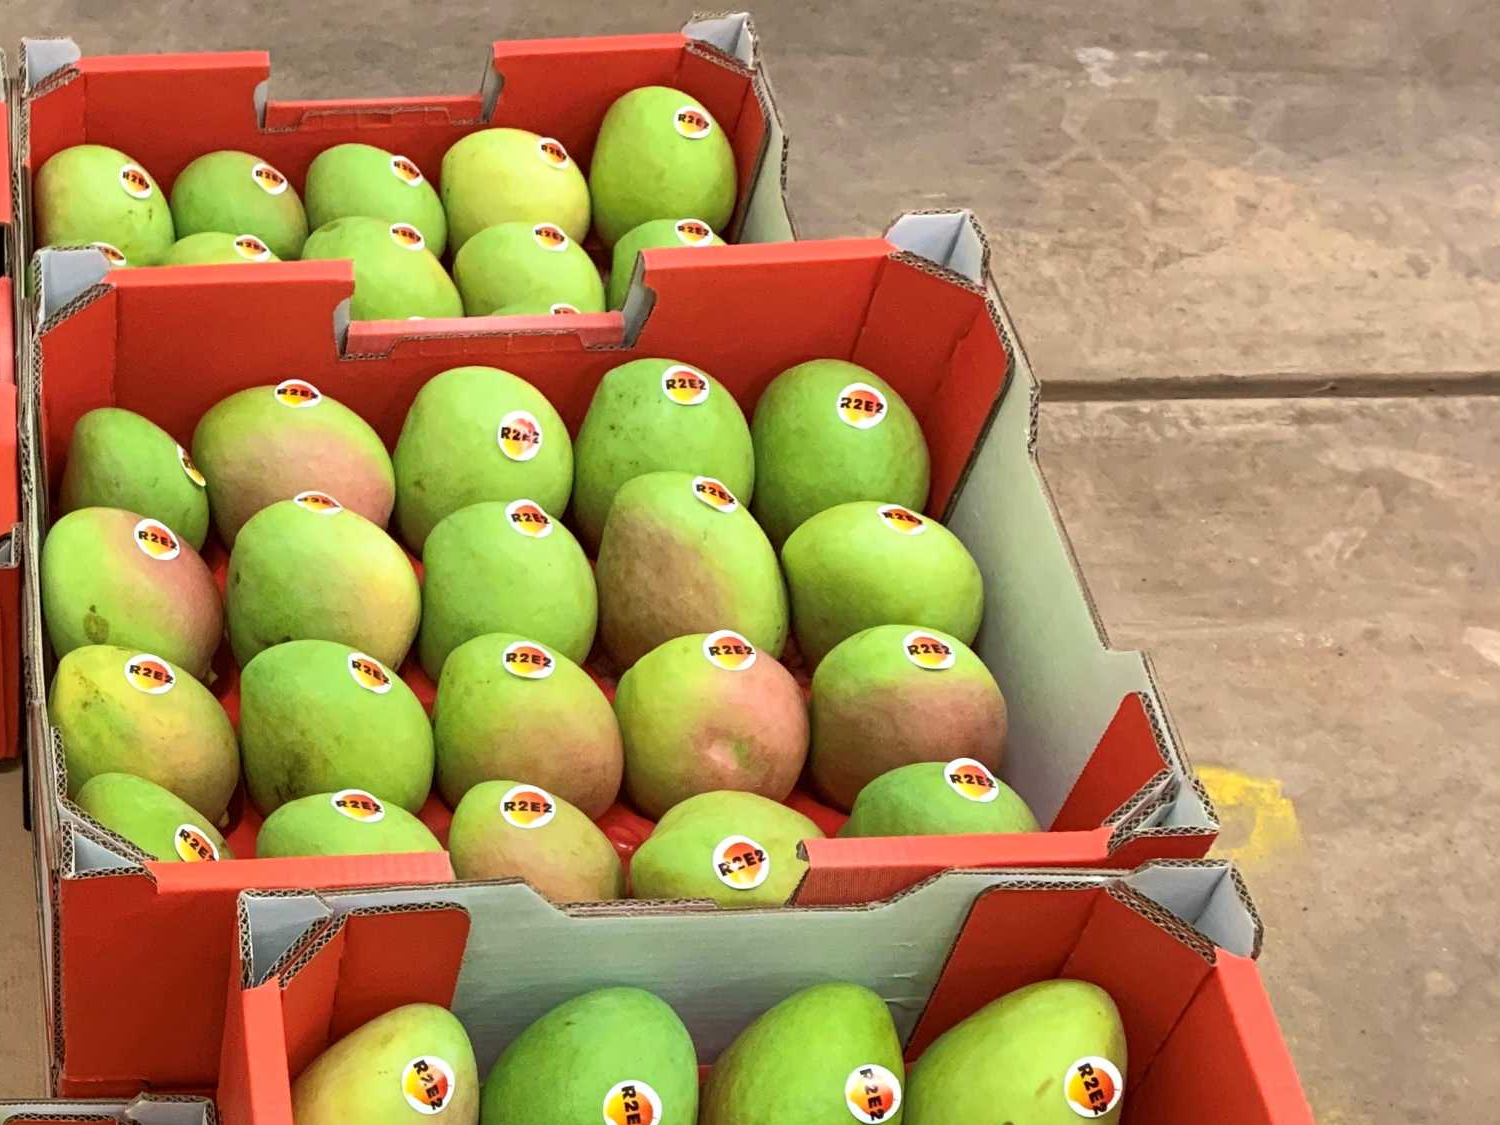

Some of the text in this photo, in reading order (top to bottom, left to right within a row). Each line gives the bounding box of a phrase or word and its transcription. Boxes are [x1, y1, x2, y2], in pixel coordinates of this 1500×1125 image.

[678, 113, 710, 129] R2E2
[665, 378, 706, 390] R2E2
[840, 397, 884, 413] R2E2
[511, 513, 550, 527] R2E2
[708, 645, 755, 657] R2E2
[907, 644, 952, 656] R2E2
[505, 652, 552, 668] R2E2
[129, 664, 174, 684] R2E2
[351, 660, 389, 684] R2E2
[948, 774, 996, 789] R2E2
[335, 800, 382, 813] R2E2
[503, 801, 552, 813] R2E2
[1077, 1063, 1108, 1116] R2E2
